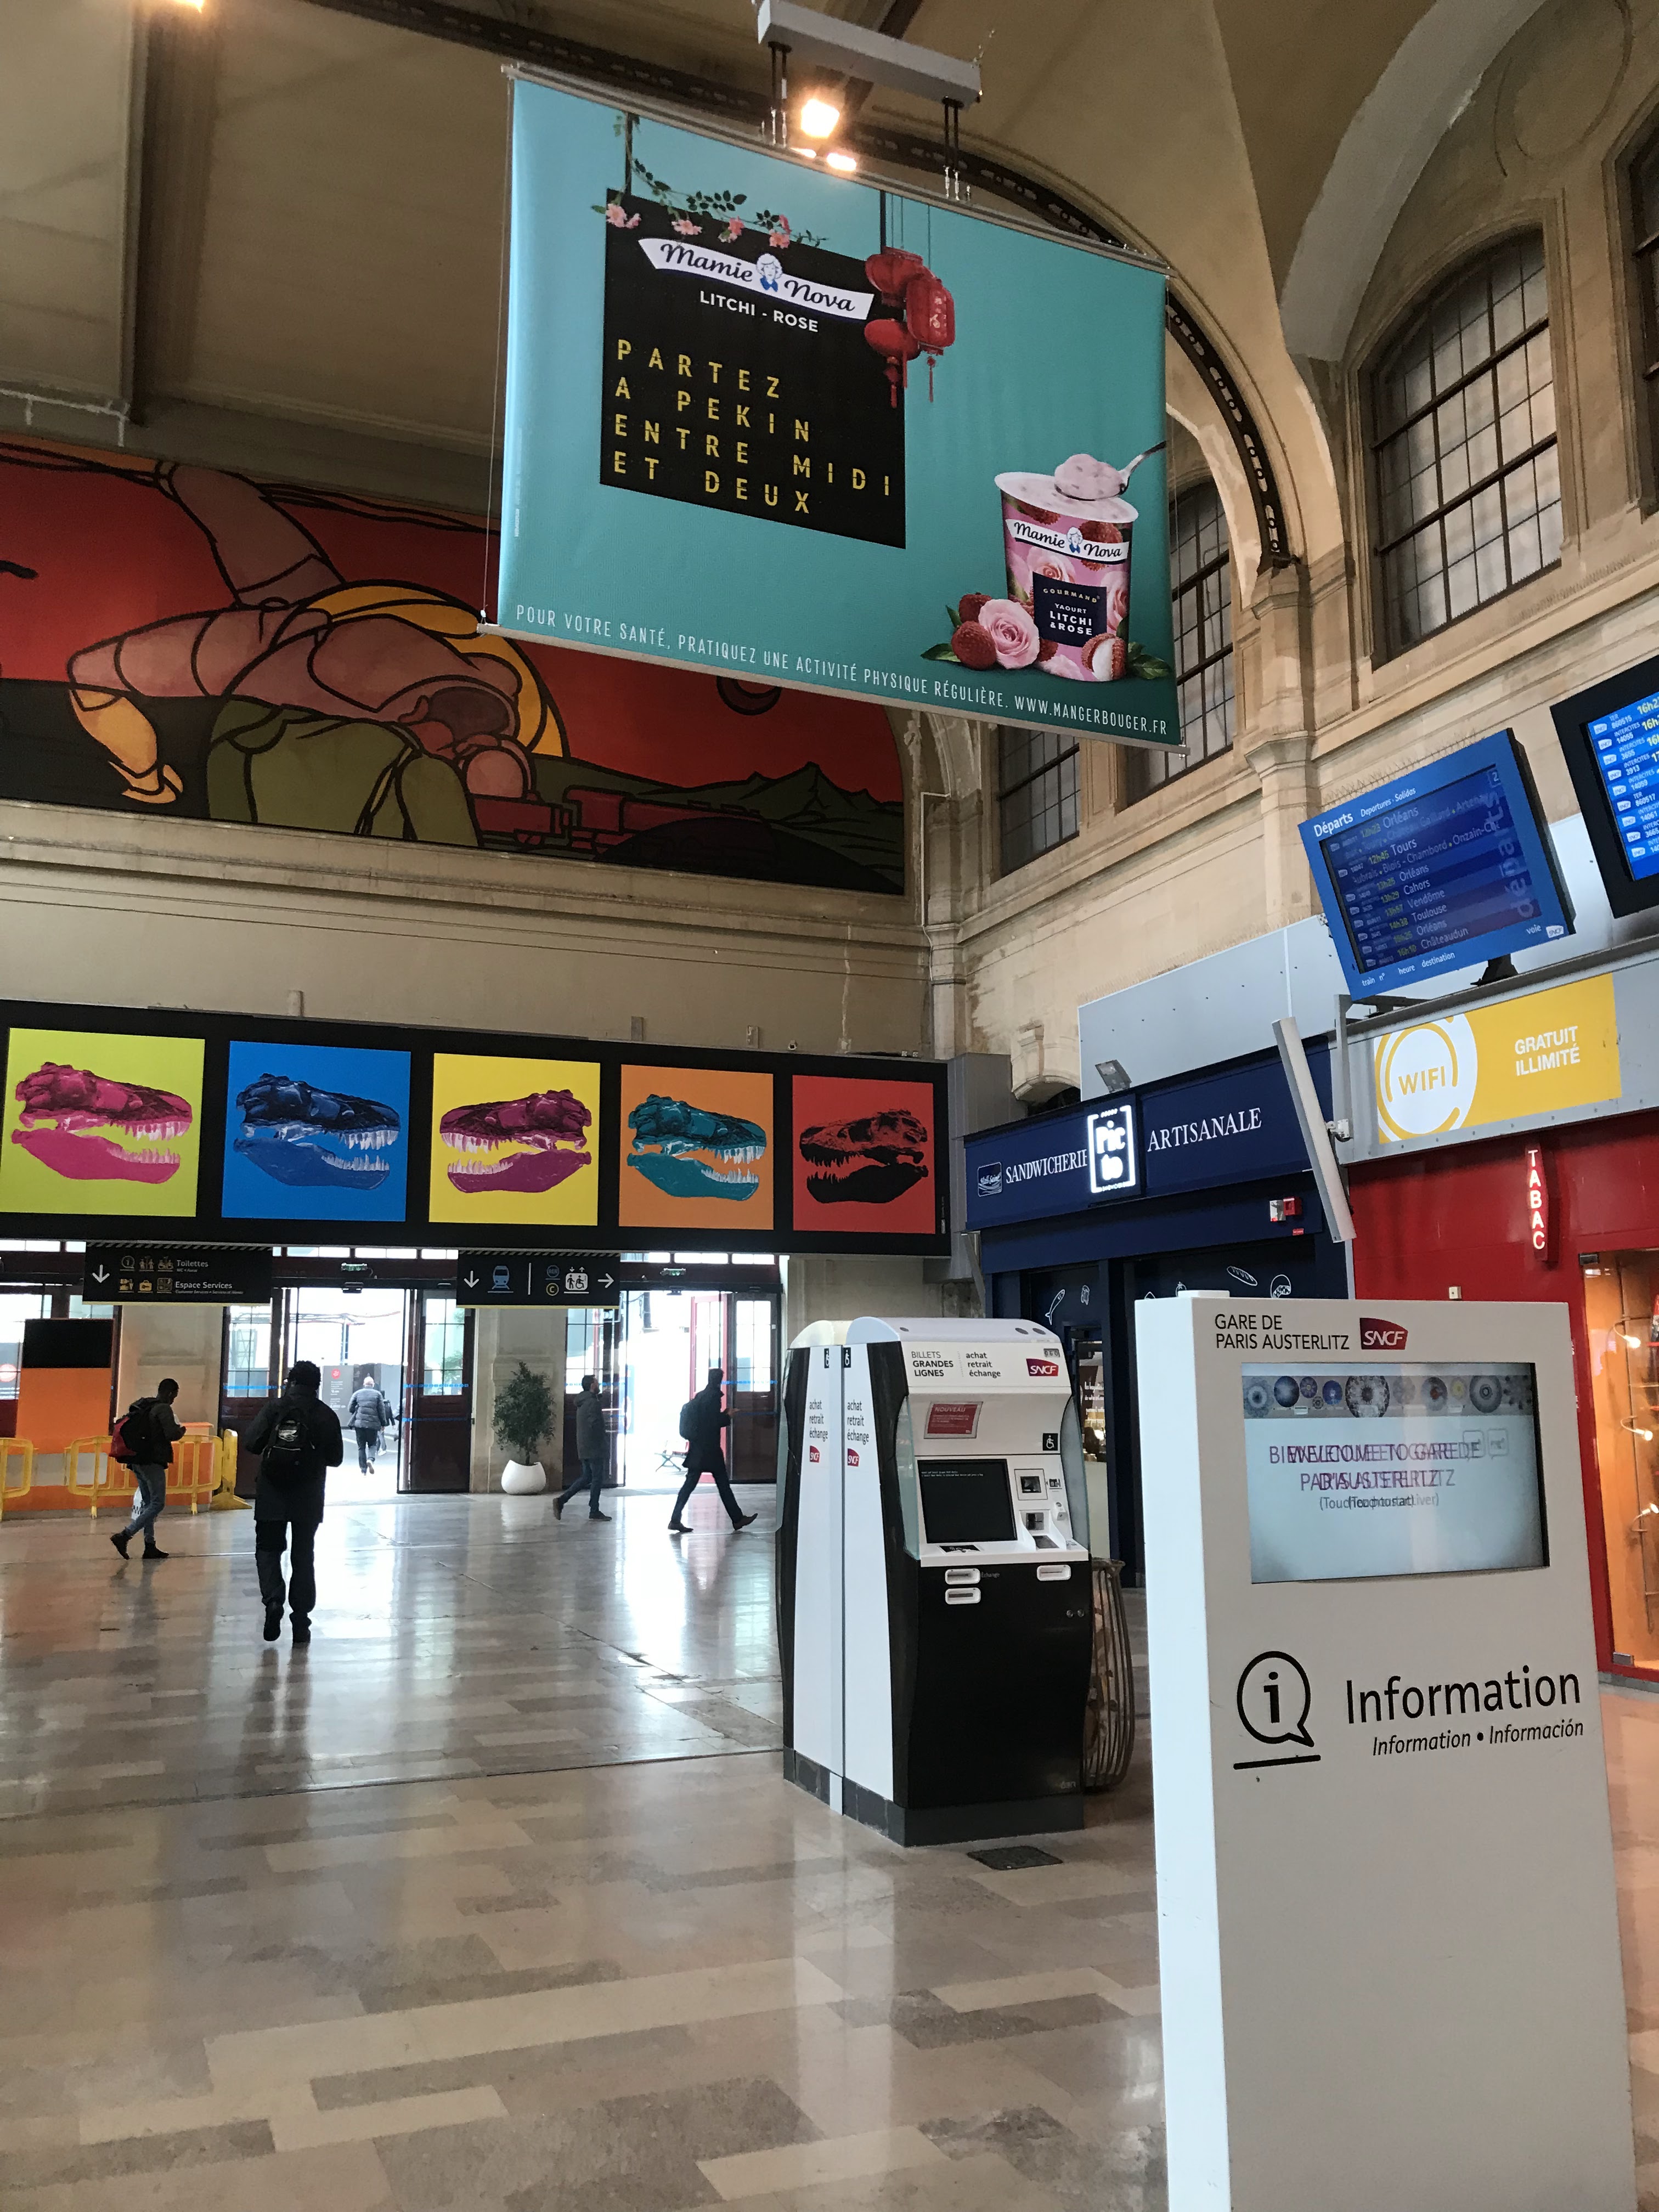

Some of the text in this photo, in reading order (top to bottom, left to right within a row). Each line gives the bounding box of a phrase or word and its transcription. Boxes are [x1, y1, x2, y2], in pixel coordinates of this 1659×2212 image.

[660, 242, 855, 313] Mamie Nova
[700, 291, 755, 317] LITCHI
[774, 311, 819, 332] ROSE
[617, 339, 780, 399] PARTEZ
[616, 376, 809, 442] A PEKIN
[615, 414, 889, 495] ENTRE MIDI
[614, 451, 809, 514] ET DEUX
[1014, 521, 1122, 559] Mamie Nova
[1054, 603, 1087, 614] YAOURT
[1049, 611, 1092, 626] LITCHI
[1050, 622, 1093, 636] &ROSE
[516, 605, 1167, 735] POUR VOTRE SANTÉ, PRATIQUEZ UNE ACTIVITÉ PHYSIQUE RÉGULIÈRE. WWW.MANGERBOUGER.FR
[1614, 722, 1640, 737] INTERCITES
[1641, 714, 1659, 731] 16h
[1619, 737, 1645, 752] INTERCITES
[1623, 753, 1650, 768] INTERCITES
[1626, 765, 1640, 776] 3913
[1628, 769, 1655, 783] INTERCITES
[1361, 798, 1392, 817] Departures
[1313, 813, 1353, 837] Départs
[1383, 807, 1419, 828] Orléans
[1390, 839, 1418, 856] Tours
[1407, 839, 1447, 863] Chambord
[1400, 864, 1430, 882] Orléans
[1403, 879, 1431, 895] Cahors
[1407, 889, 1446, 909] Vendôme
[1411, 904, 1448, 922] Toulouse
[1416, 919, 1447, 935] Orléans
[1526, 924, 1542, 935] voie
[1420, 927, 1469, 949] Châteaudun
[1362, 977, 1376, 986] train
[1398, 964, 1415, 975] heure
[1421, 952, 1455, 968] destination
[1515, 1025, 1579, 1055] GRATUIT
[1516, 1046, 1581, 1076] ILLIMITÉ
[1398, 1065, 1446, 1096] WIFI
[1005, 1107, 1262, 1184] SANDWICHERIE ARTISANALE
[1528, 1149, 1545, 1250] TABAC
[1215, 1314, 1282, 1330] GARE DE
[1215, 1334, 1350, 1351] PARIS AUSTERLITZ
[1363, 1330, 1405, 1346] SNCF
[969, 1369, 1001, 1378] échange
[1030, 1365, 1057, 1374] SNCF
[809, 1399, 822, 1410] achat
[847, 1400, 862, 1411] achat
[809, 1413, 824, 1424] retrait
[847, 1415, 864, 1426] retrait
[809, 1427, 828, 1442] échange
[847, 1429, 869, 1445] échange
[810, 1452, 819, 1460] SNCF
[848, 1455, 859, 1464] SNCF
[1346, 1665, 1581, 1724] Information
[1372, 1718, 1584, 1756] Information Información
